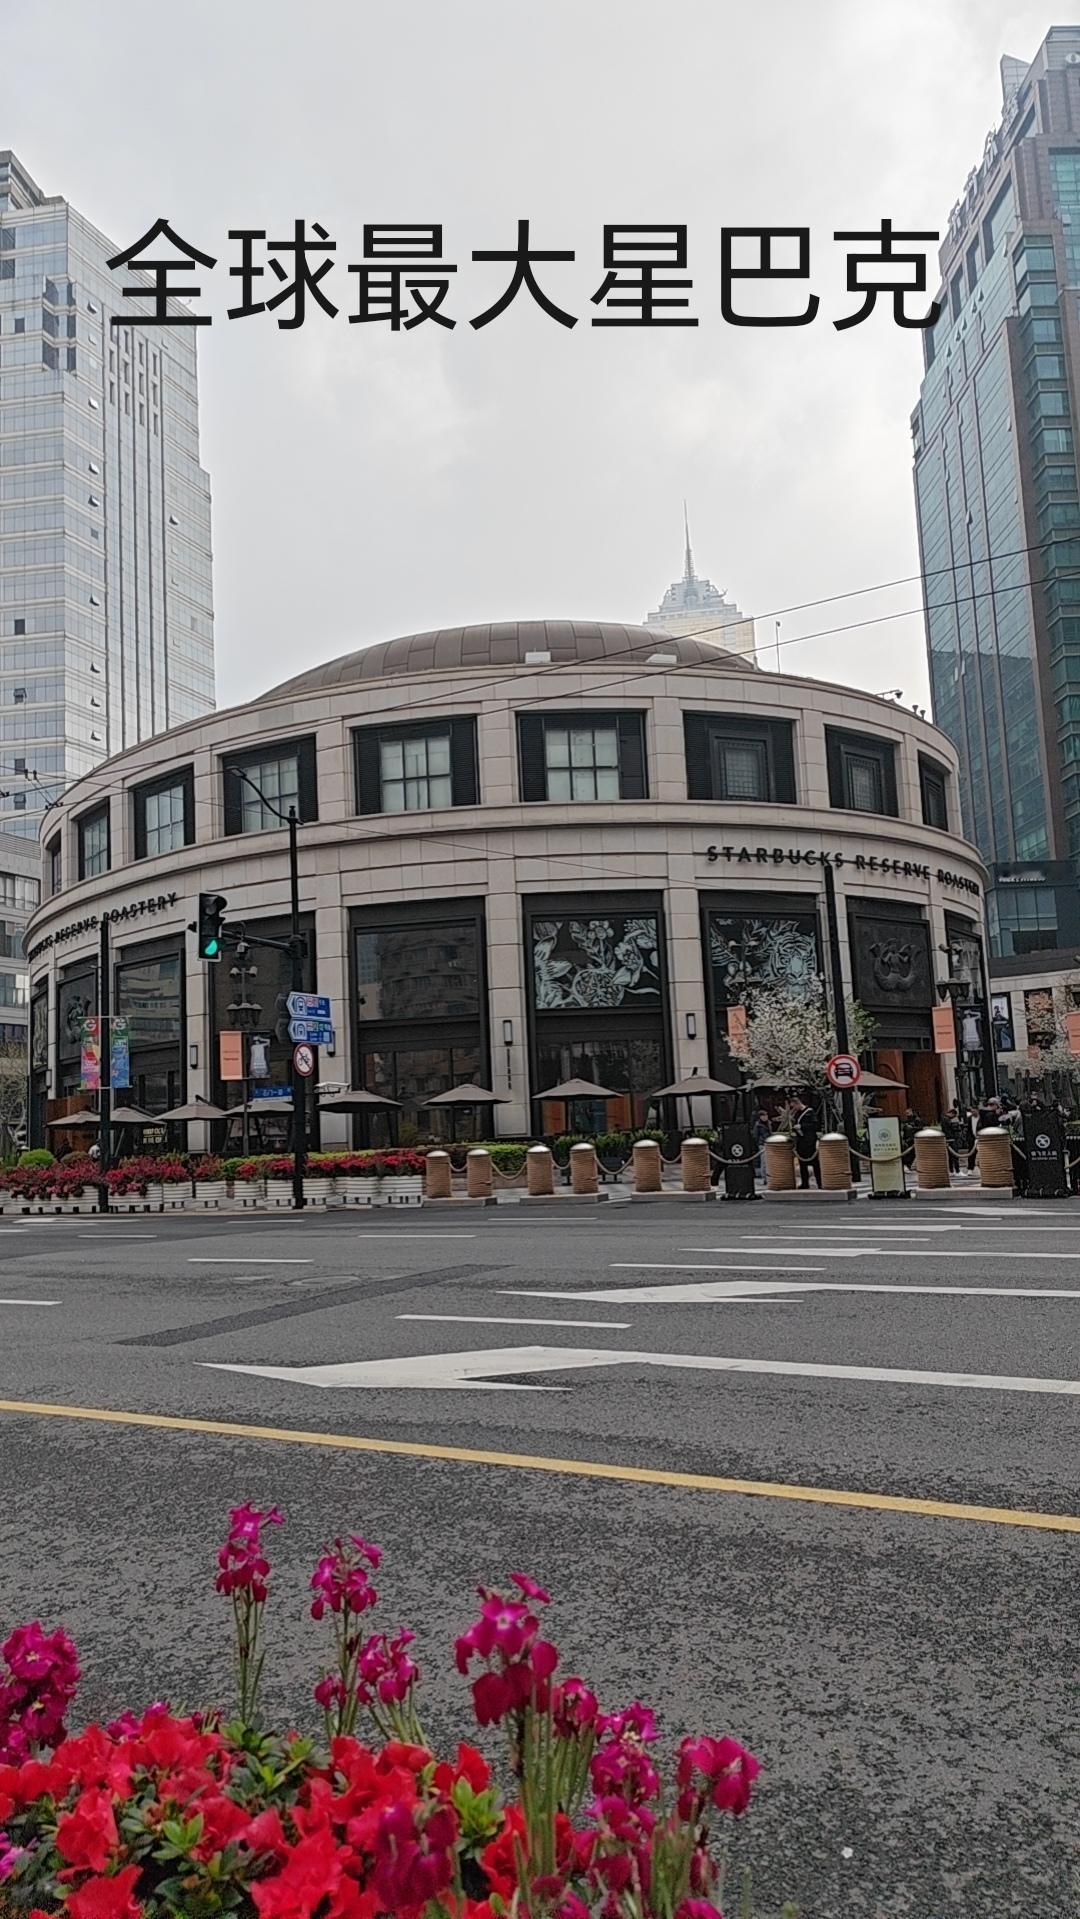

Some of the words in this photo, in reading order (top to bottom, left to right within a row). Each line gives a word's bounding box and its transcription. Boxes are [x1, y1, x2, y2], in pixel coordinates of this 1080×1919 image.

[707, 846, 844, 868] STARBUCKS
[856, 855, 930, 880] RESERVE
[102, 892, 177, 923] ROASTERY
